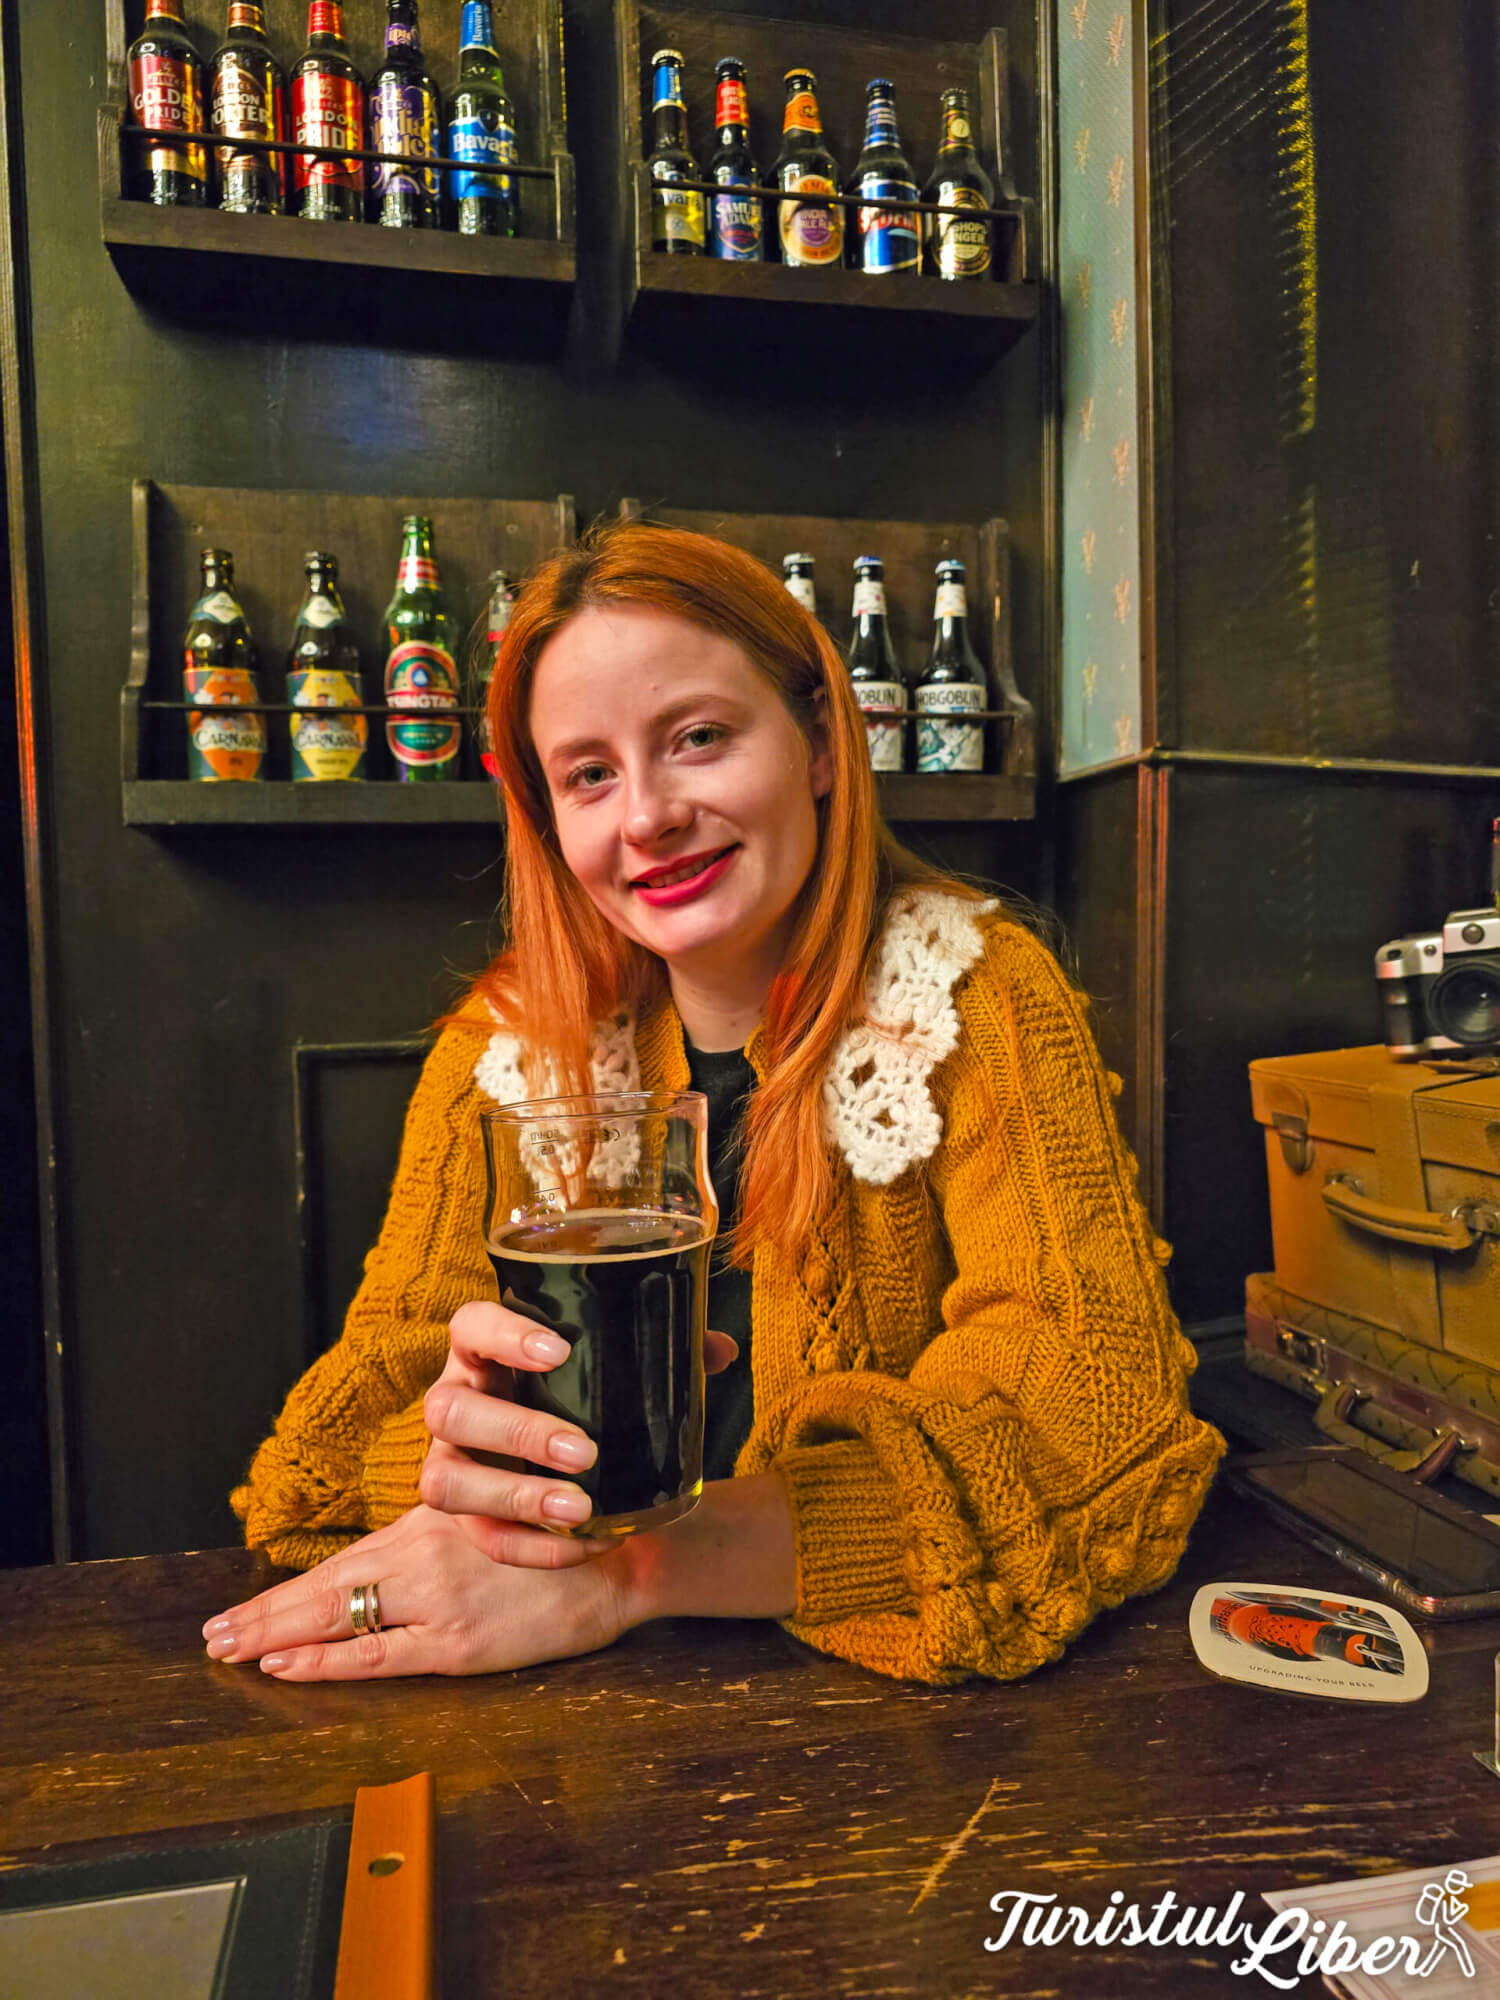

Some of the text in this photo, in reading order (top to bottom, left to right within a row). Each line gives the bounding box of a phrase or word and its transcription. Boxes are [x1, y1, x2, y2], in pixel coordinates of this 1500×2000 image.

[856, 688, 895, 705] OBLIN
[916, 689, 980, 705] HOBGOBLIN
[1249, 1664, 1312, 1682] UPGRADING
[1317, 1677, 1345, 1686] YOUR
